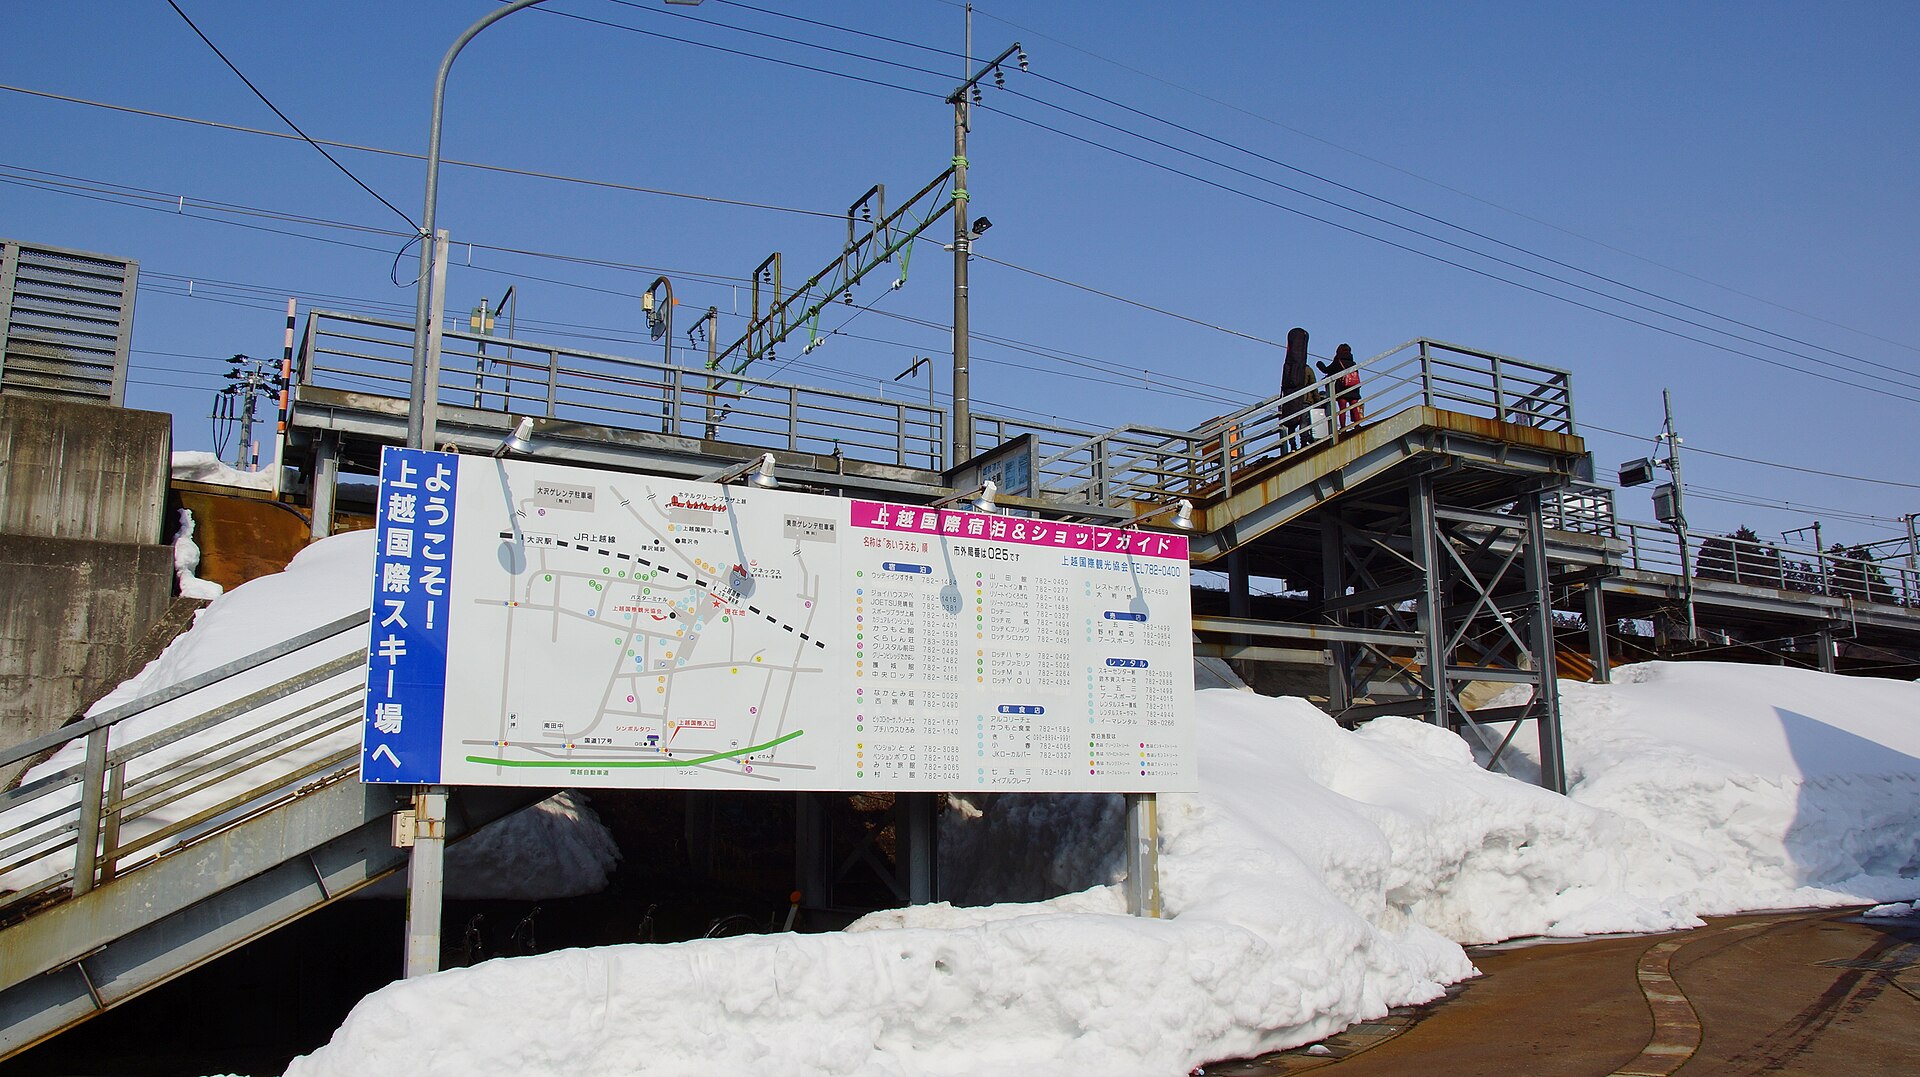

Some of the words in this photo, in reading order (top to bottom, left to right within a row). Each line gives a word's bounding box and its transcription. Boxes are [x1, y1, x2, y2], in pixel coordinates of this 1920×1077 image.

[537, 487, 593, 500] 大沢ゲレンデ駐車場
[678, 492, 746, 504] ホテルグリーンプラザ上越
[683, 526, 729, 535] 上越国際スキー場
[871, 509, 1171, 554] 上越国際宿泊&ショップガイド
[527, 536, 552, 545] 大沢駅
[574, 533, 616, 544] JR上越線
[418, 461, 453, 630] ようこそ!
[953, 545, 1021, 562] 市外局番は025です
[752, 567, 781, 575] アネックス
[372, 461, 418, 769] 上越国際スキー場へ
[612, 606, 662, 615] 上越国際観光協会
[724, 609, 746, 617] 現在地
[872, 626, 914, 634] かつもと館
[1109, 659, 1146, 667] レンタル
[874, 689, 914, 698] なかとみ荘
[1003, 706, 1040, 714] 飲食店
